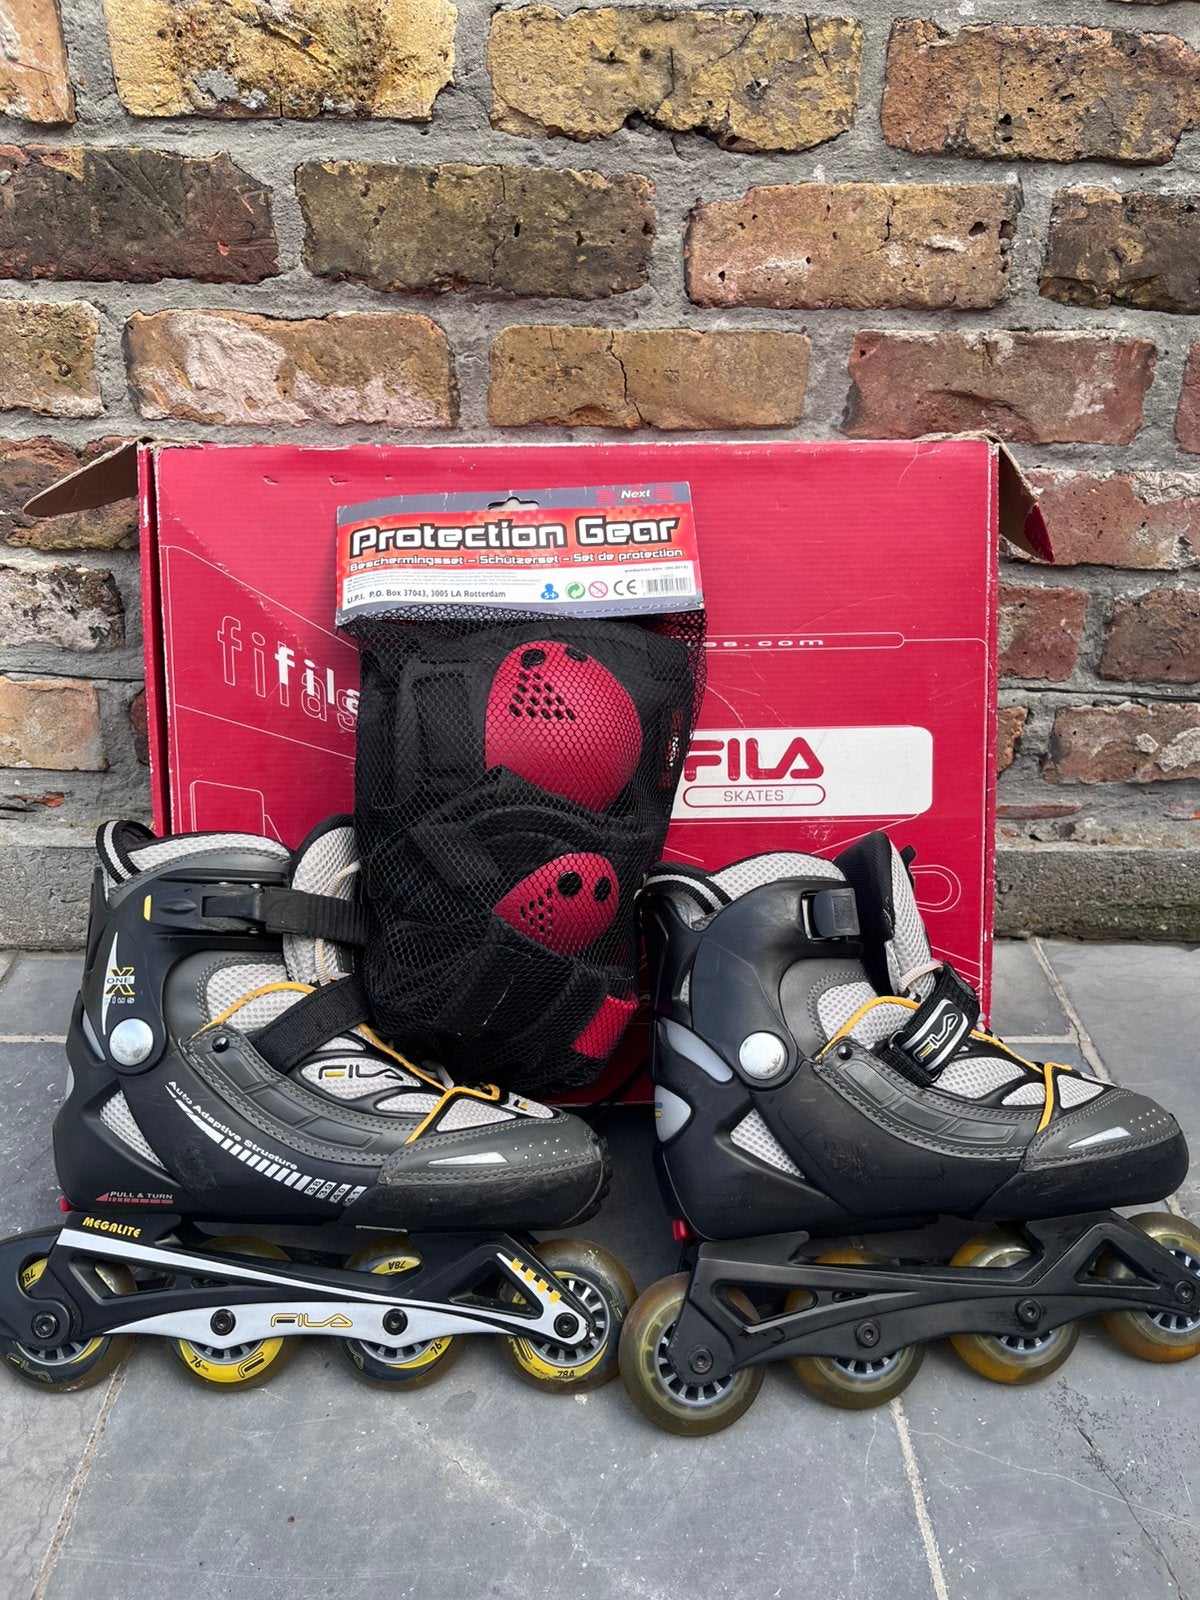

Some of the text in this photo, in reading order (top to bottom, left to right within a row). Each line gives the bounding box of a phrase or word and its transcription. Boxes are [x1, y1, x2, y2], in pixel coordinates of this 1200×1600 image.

[620, 489, 651, 499] Next
[351, 516, 680, 558] Protection Gear
[350, 555, 464, 572] Beschermingsset
[573, 553, 595, 563] Set
[597, 551, 615, 561] de
[618, 548, 683, 563] protection
[369, 589, 384, 598] P.O.
[386, 589, 402, 598] Box
[404, 589, 429, 599] 37043,
[431, 589, 449, 598] 3005
[451, 590, 462, 598] LA
[464, 589, 506, 598] Rotterdam
[684, 736, 825, 782] FILA
[723, 790, 784, 803] SKATES
[913, 1013, 958, 1062] FILA
[318, 1064, 404, 1081] FILA
[168, 1080, 298, 1171] Auto Adaptive Structure
[110, 1190, 134, 1198] PULL
[82, 1216, 141, 1238] MEGALITE
[271, 1313, 353, 1328] FILA
